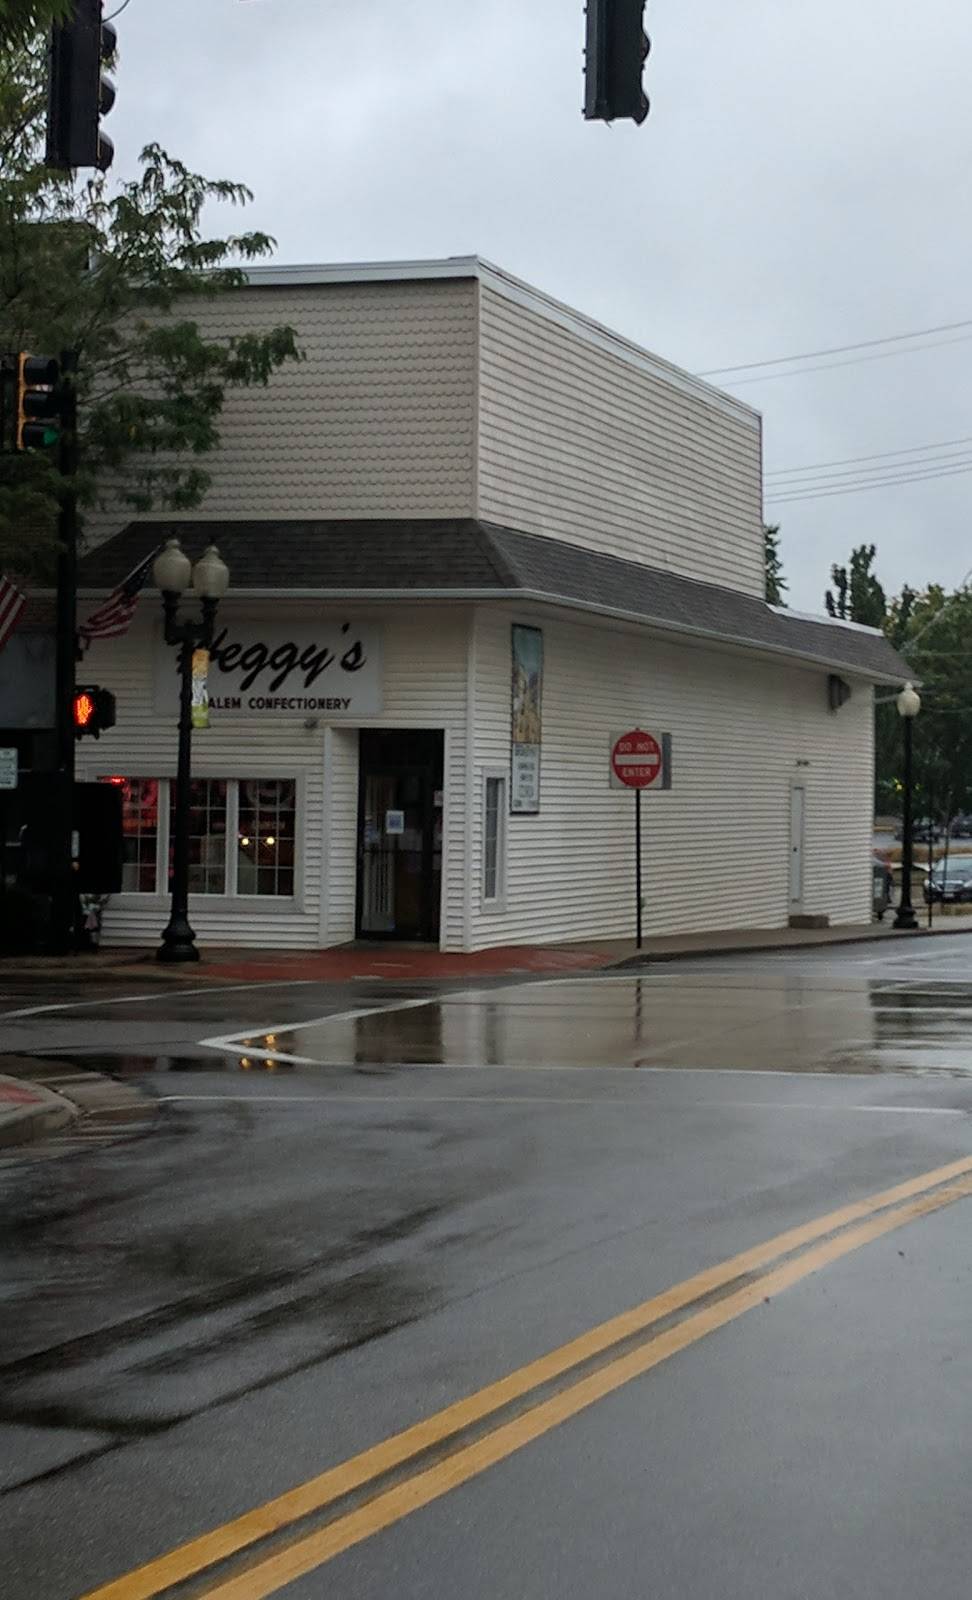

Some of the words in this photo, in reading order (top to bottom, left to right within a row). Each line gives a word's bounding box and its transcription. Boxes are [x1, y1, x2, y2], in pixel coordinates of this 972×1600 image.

[207, 697, 241, 710] ALEM
[248, 697, 351, 710] CONFECTIONERY
[619, 742, 633, 752] DO
[636, 741, 655, 752] NOT
[623, 766, 652, 778] ENTER
